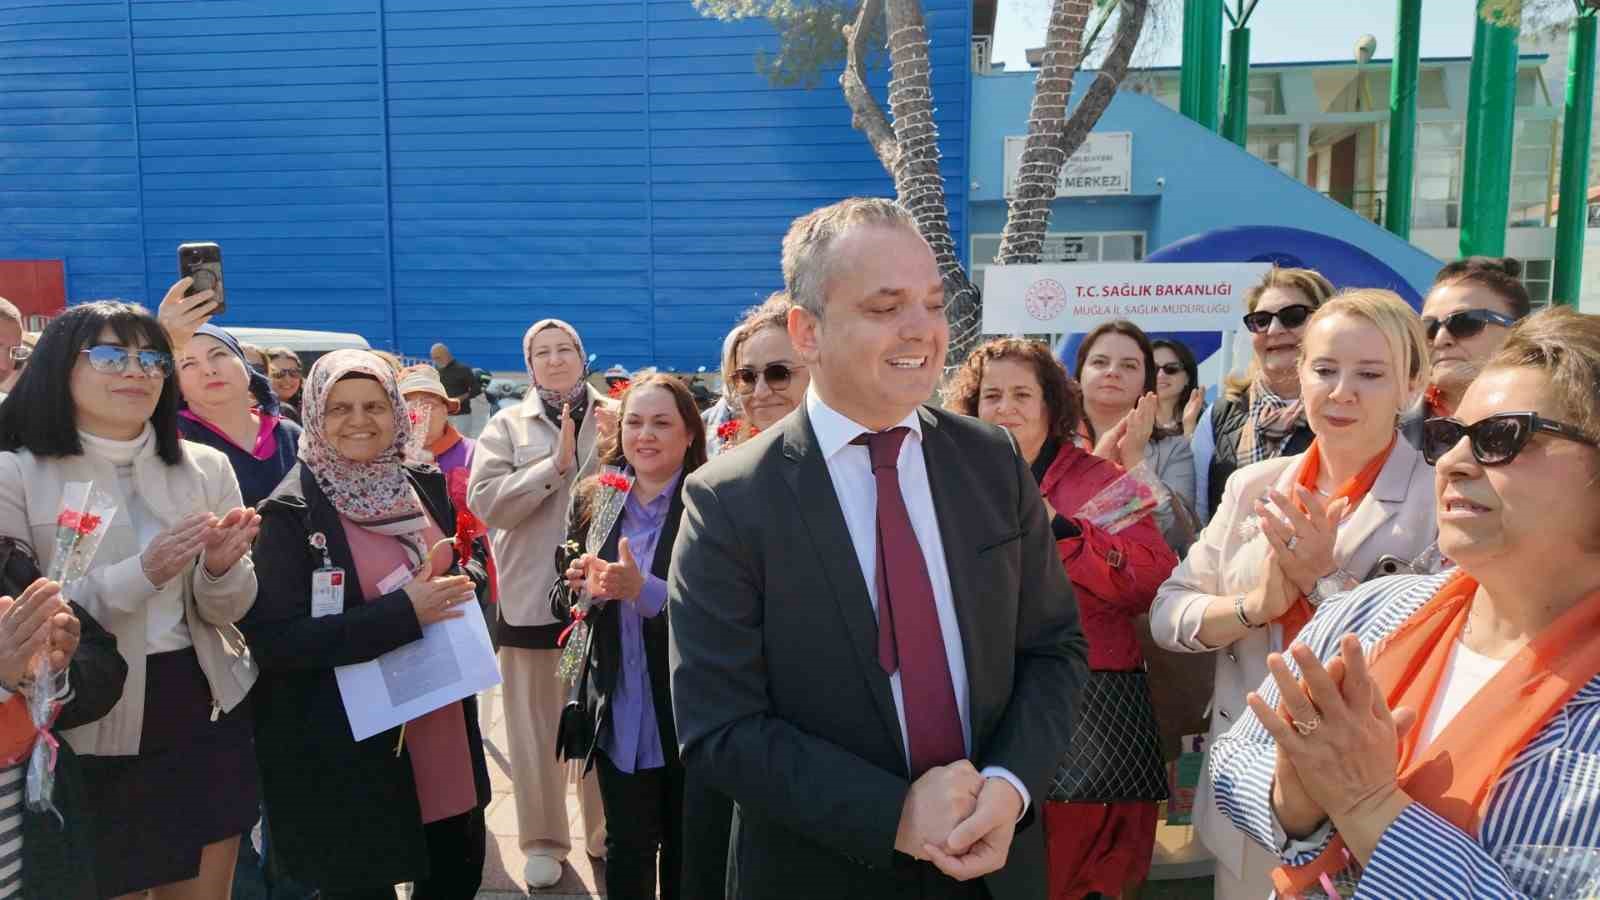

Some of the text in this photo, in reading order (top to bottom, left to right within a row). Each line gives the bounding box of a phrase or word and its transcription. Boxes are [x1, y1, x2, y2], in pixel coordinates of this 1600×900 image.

[1075, 281, 1232, 298] T.C. SAĞLIK BAKANLIĞI
